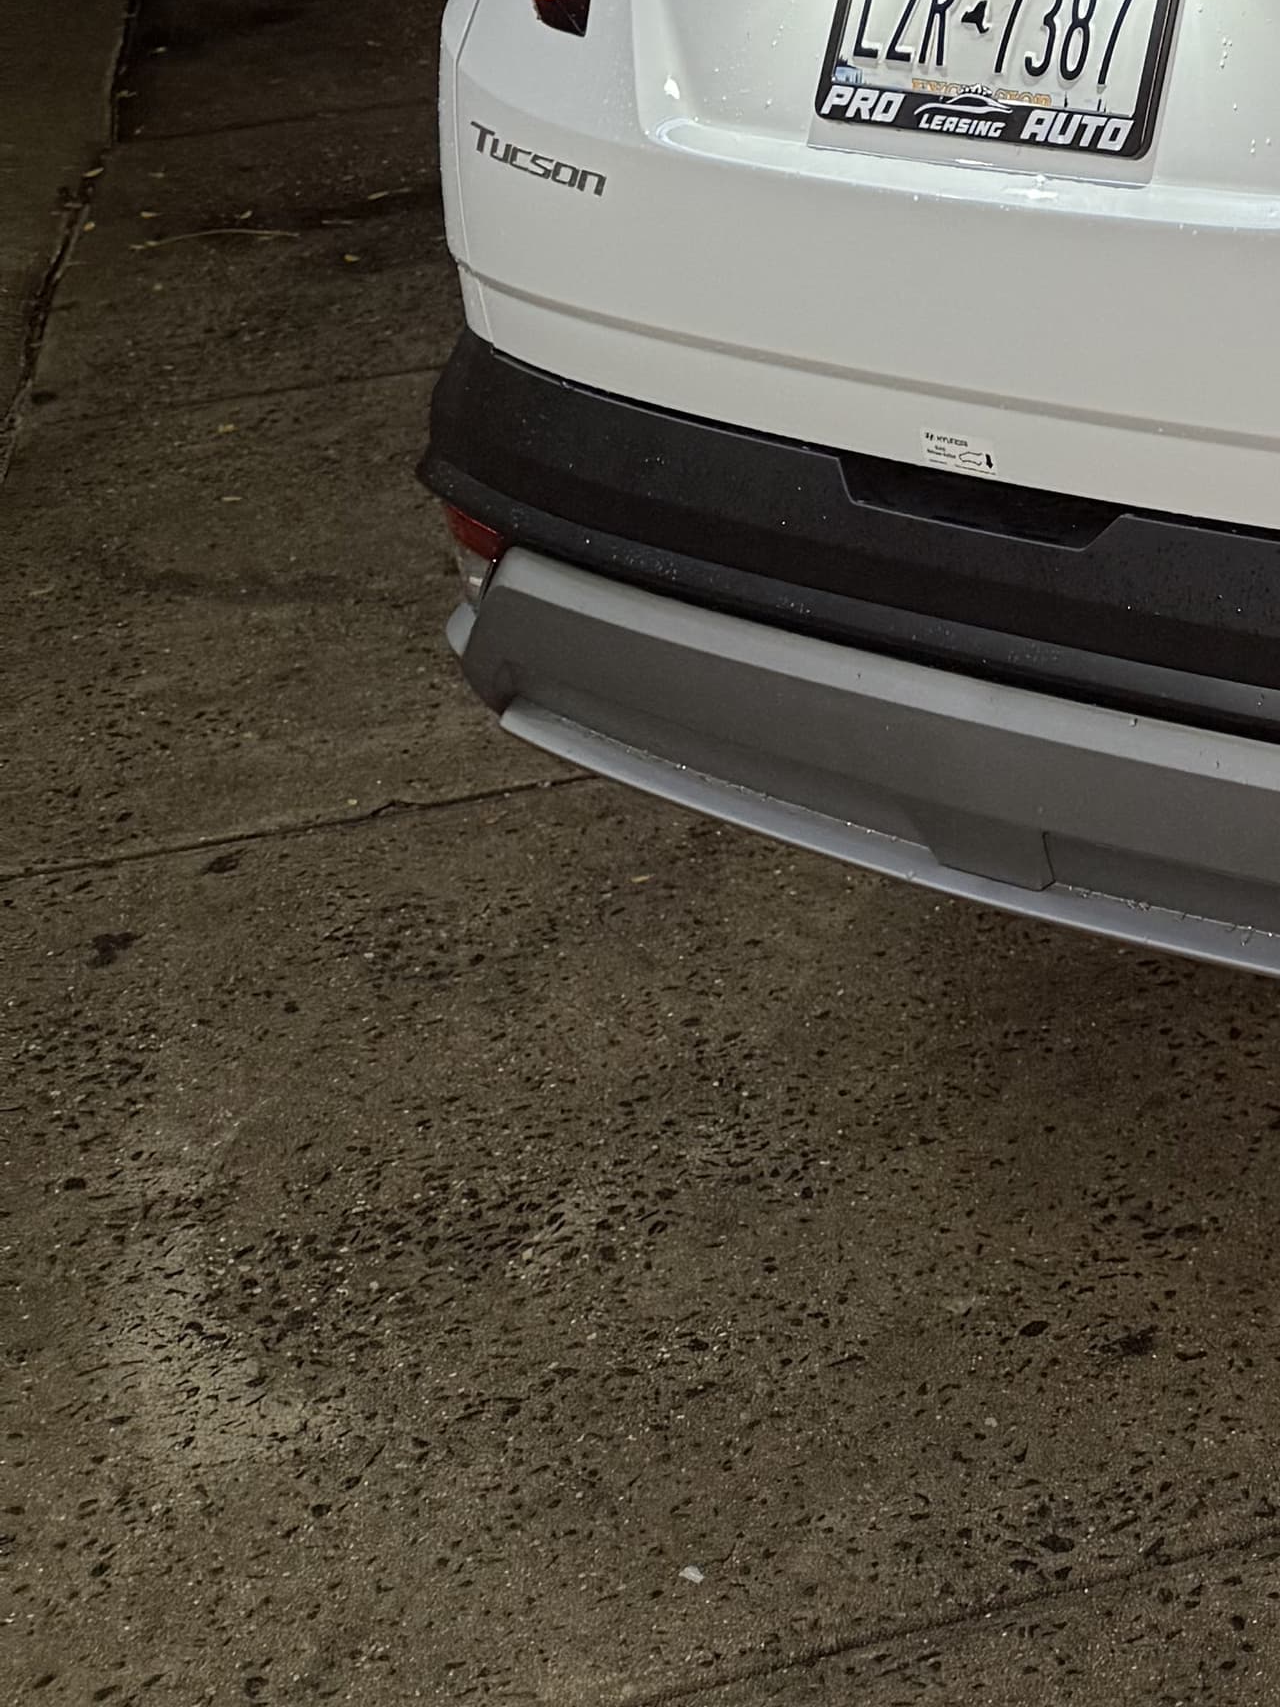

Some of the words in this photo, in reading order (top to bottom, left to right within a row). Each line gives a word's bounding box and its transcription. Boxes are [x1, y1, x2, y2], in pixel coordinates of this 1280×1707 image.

[820, 85, 906, 123] PRO
[1019, 109, 1135, 152] AUTO
[918, 113, 1007, 138] LEASING
[470, 120, 608, 197] Tucson
